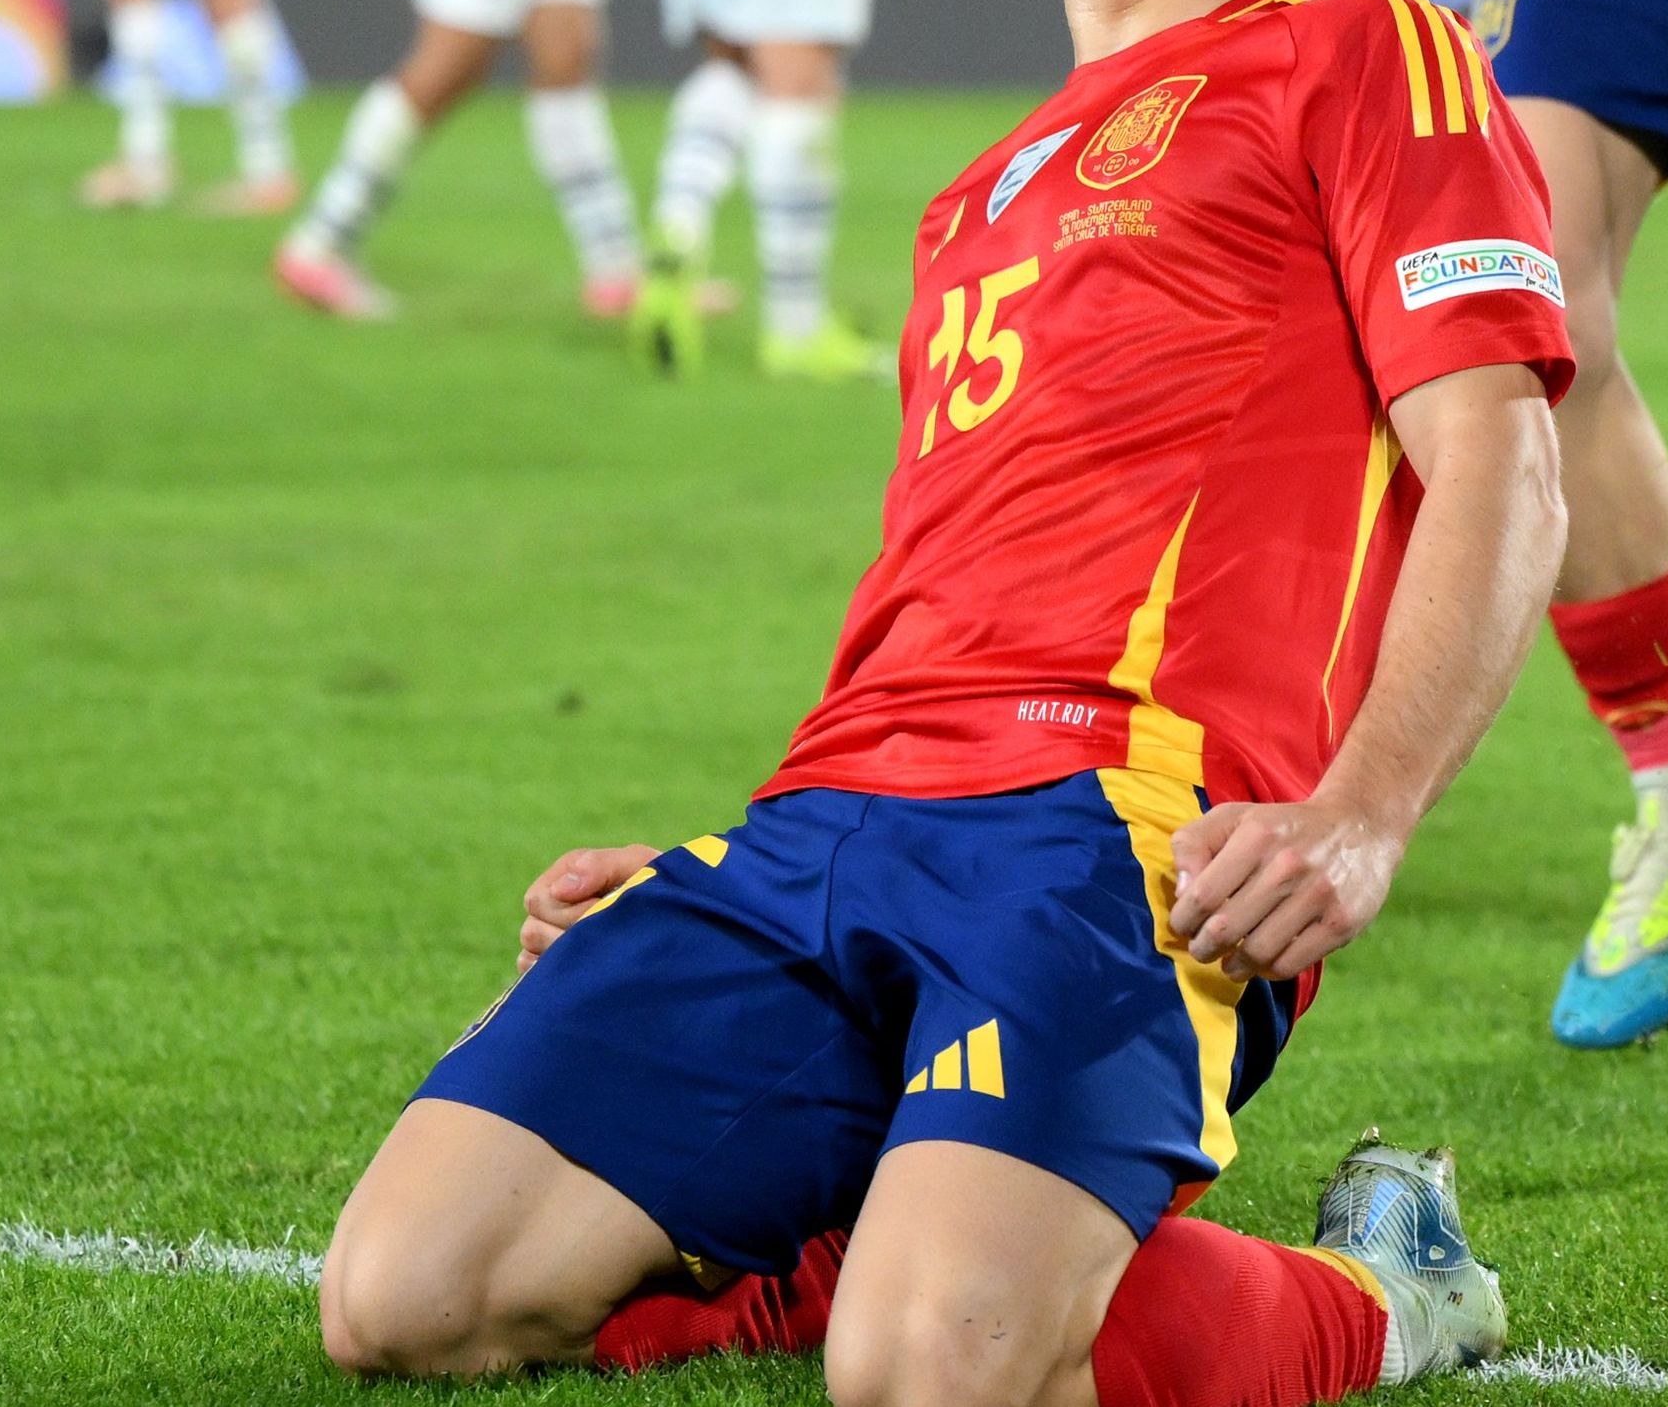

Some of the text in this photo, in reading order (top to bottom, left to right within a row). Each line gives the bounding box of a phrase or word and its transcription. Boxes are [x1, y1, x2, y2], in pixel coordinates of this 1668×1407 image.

[1058, 208, 1080, 226] SPAIN
[1087, 199, 1152, 216] SWITZERLAND
[1061, 211, 1145, 237] 18 NOVEMBER 2024
[1053, 223, 1158, 253] SANTA CRUZ DE TENERIFE
[1402, 251, 1440, 272] UEFA
[1404, 255, 1559, 291] FOUNDATION
[1525, 276, 1537, 288] for
[917, 255, 1040, 461] 15
[1017, 700, 1098, 728] HEAT.RDY
